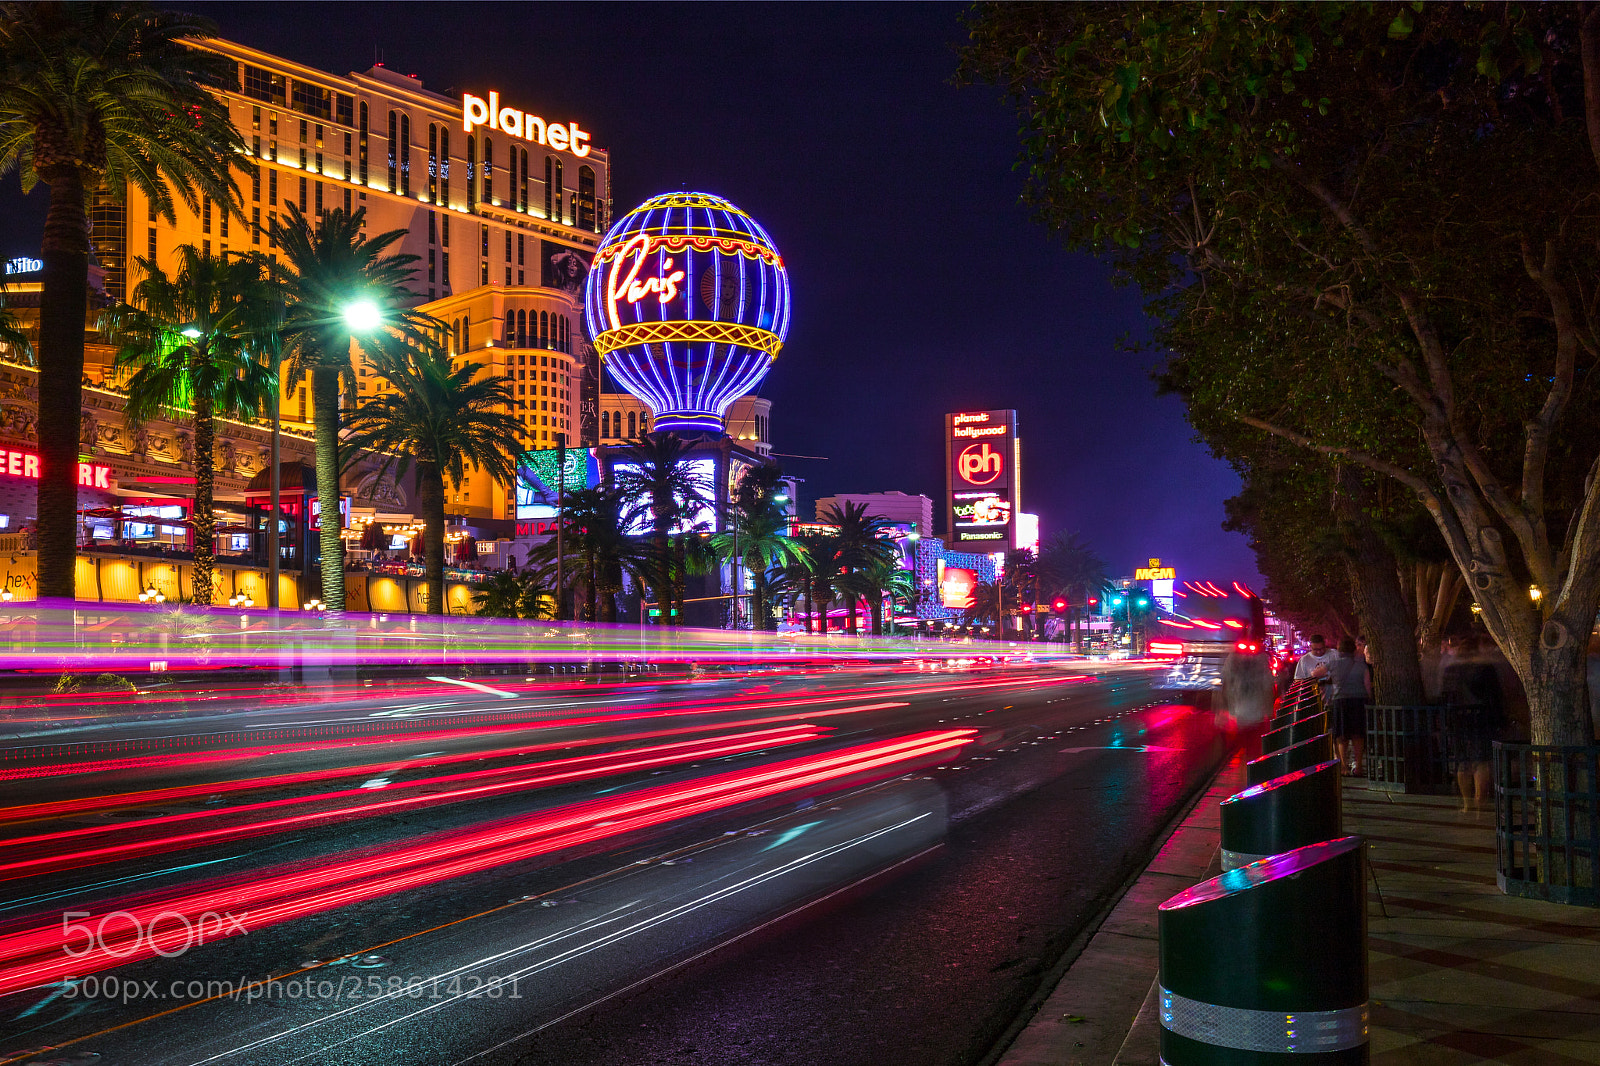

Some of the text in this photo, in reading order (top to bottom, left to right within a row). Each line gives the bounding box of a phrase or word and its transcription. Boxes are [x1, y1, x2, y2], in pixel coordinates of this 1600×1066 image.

[463, 91, 591, 158] planet
[607, 234, 684, 331] Paris
[953, 412, 990, 426] planet
[953, 424, 1007, 439] hollywood
[959, 443, 1004, 485] ph
[78, 463, 110, 489] RK
[960, 531, 1004, 541] Panasonic
[1135, 567, 1177, 580] MGM
